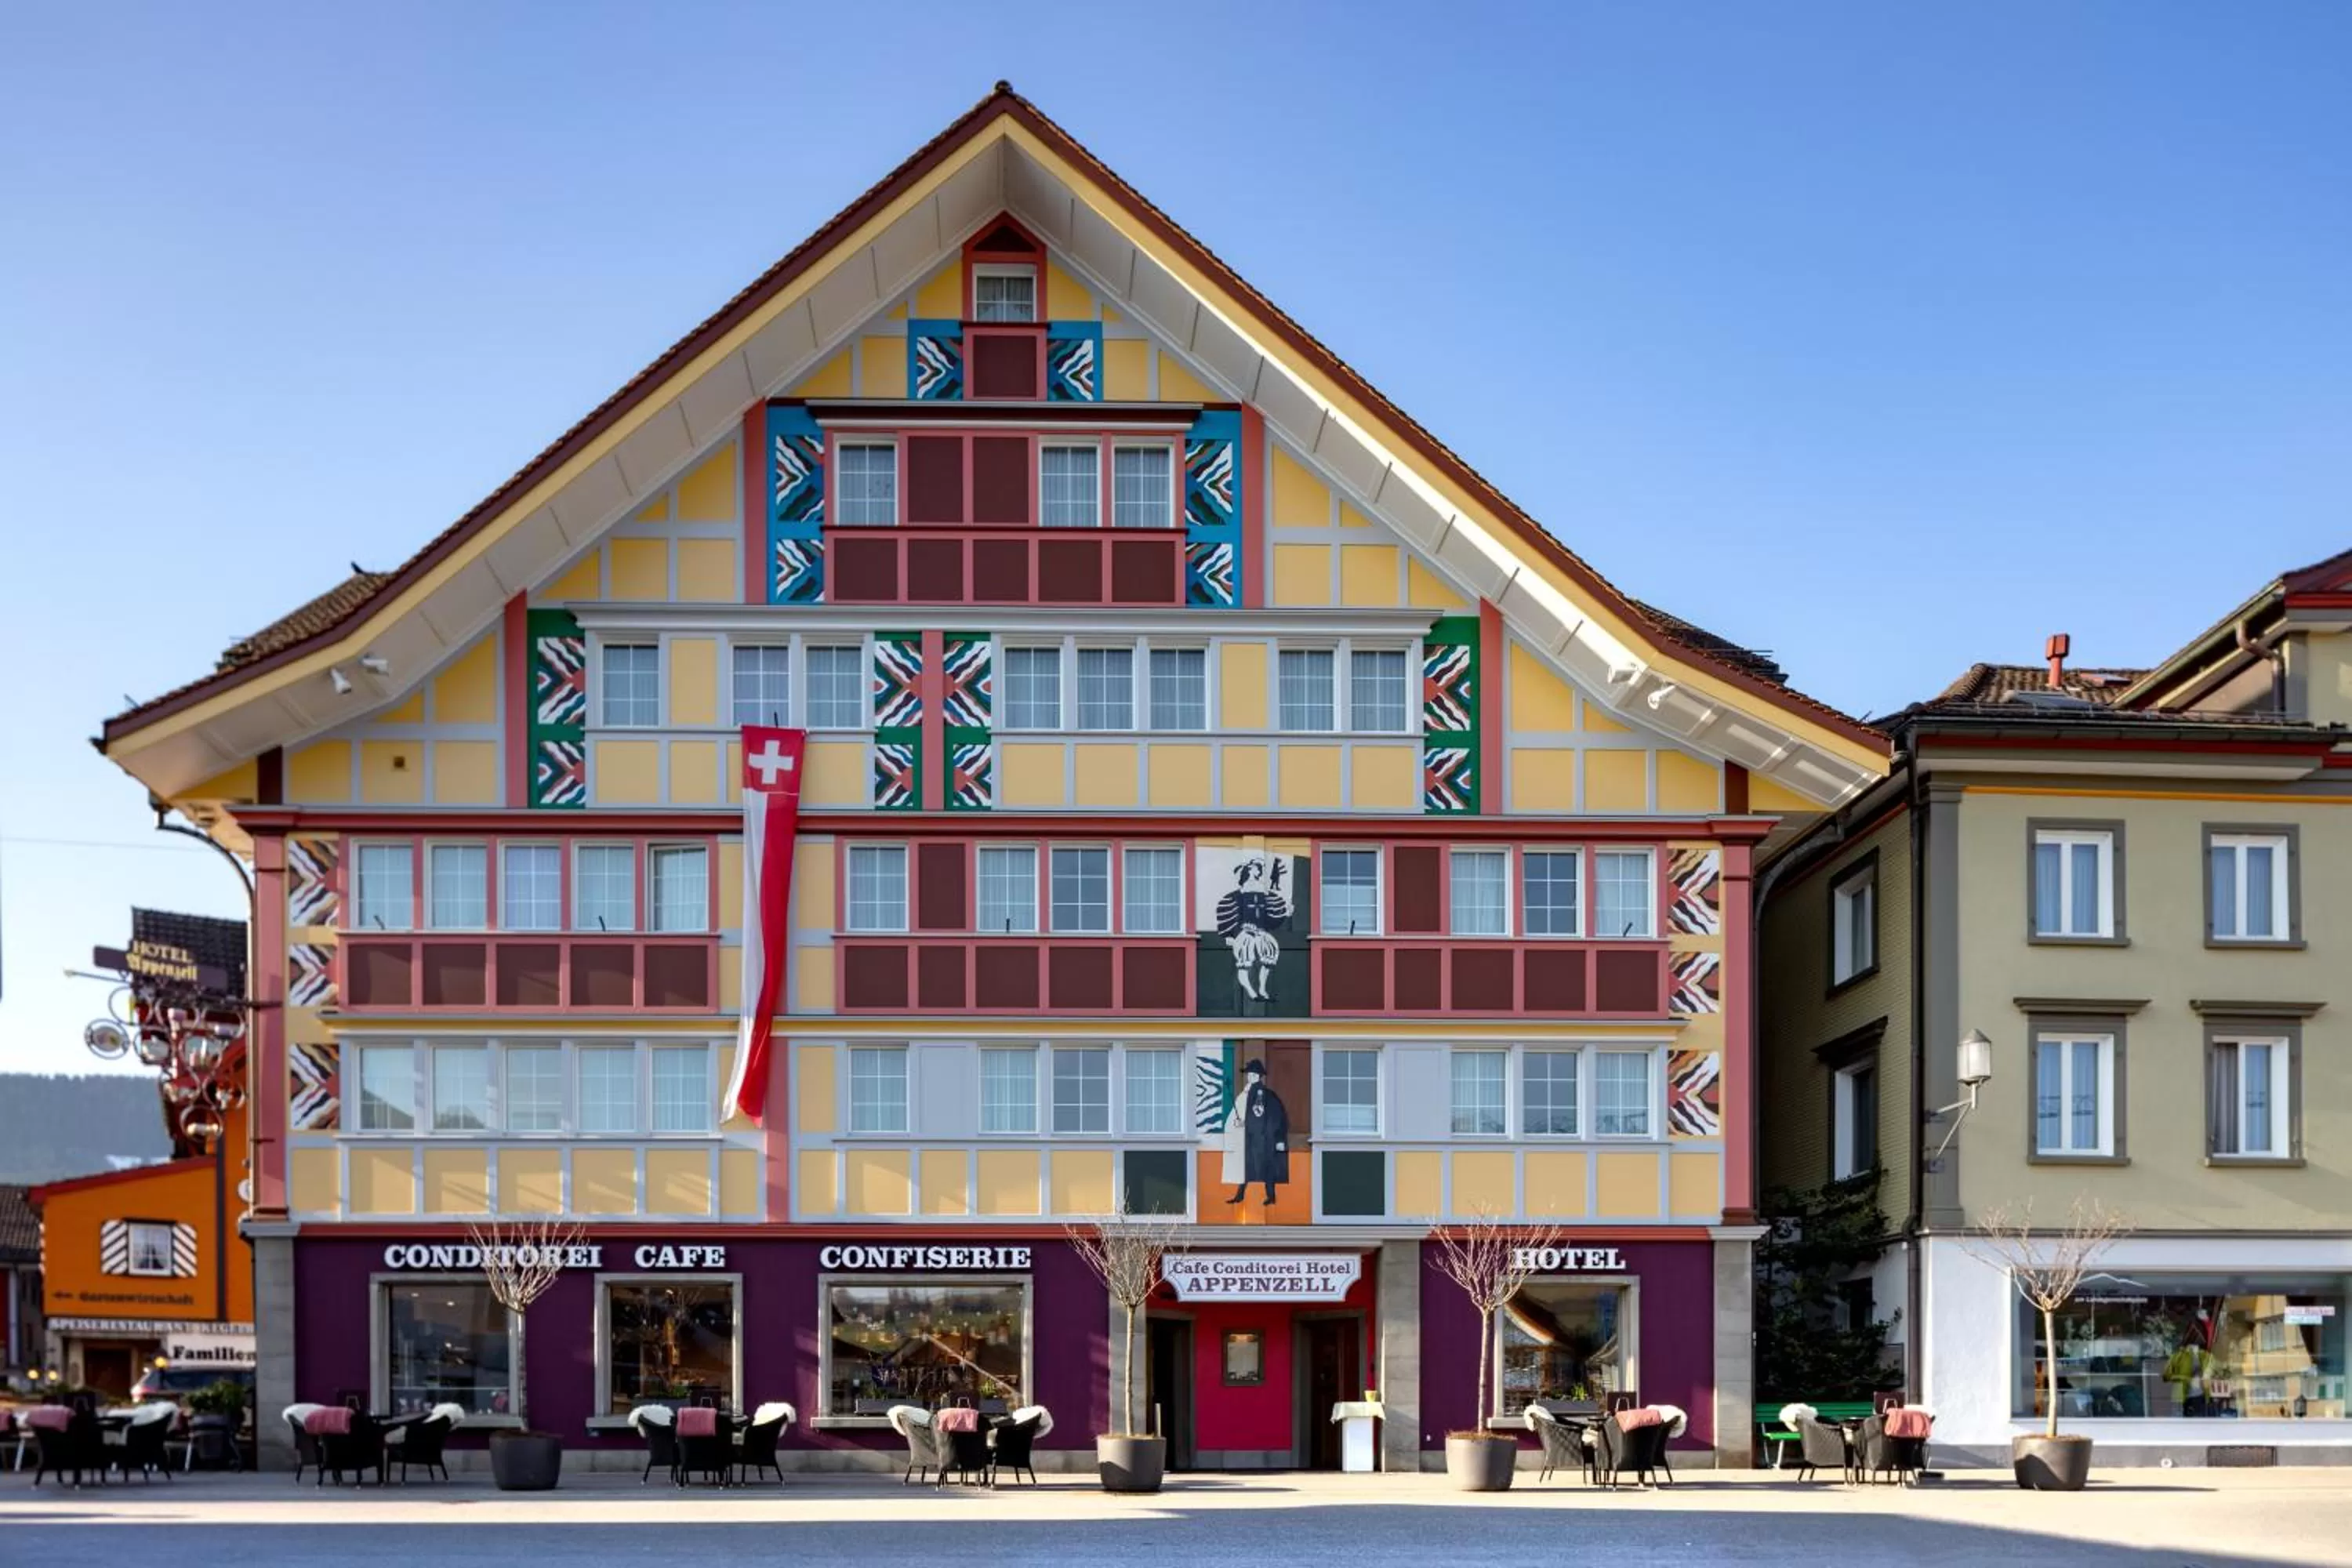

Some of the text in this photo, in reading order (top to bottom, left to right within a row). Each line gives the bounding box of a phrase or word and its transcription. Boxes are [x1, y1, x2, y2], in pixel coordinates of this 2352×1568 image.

[132, 940, 194, 964] HOTEL
[384, 1245, 725, 1268] CONDITOREI CAFE
[820, 1246, 1031, 1269] CONFISERIE
[1173, 1261, 1351, 1274] Cafe Conditorei Hotel
[1512, 1247, 1626, 1270] HOTEL
[1188, 1277, 1335, 1293] APPENZELL
